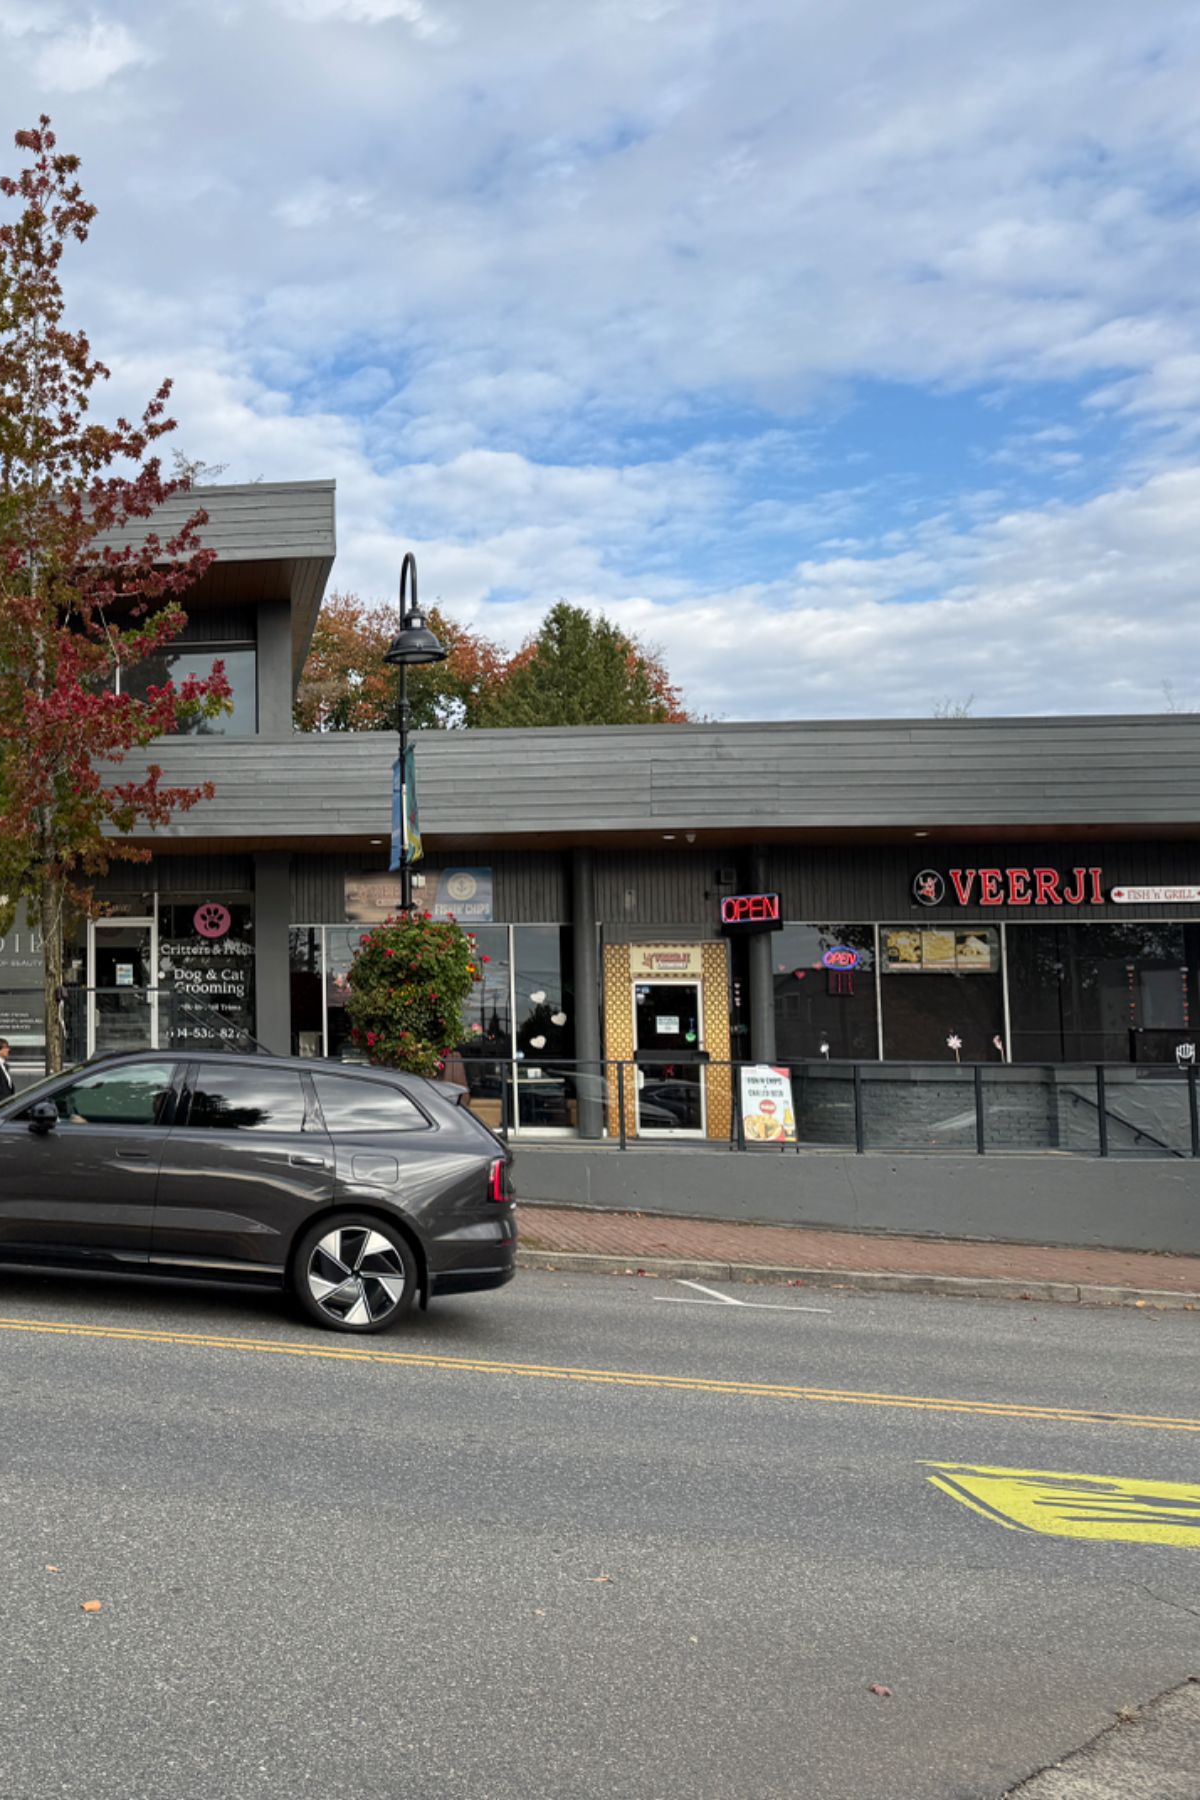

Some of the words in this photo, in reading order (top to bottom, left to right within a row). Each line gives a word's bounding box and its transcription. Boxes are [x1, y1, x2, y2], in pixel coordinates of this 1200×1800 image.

[949, 868, 1104, 905] VEERJI
[1127, 889, 1150, 900] FISH
[1164, 889, 1196, 900] GRILL
[464, 903, 490, 915] CHIPS
[722, 896, 779, 922] OPEN
[161, 943, 210, 955] Critters
[824, 952, 856, 965] OPEN
[174, 968, 203, 984] Dog
[206, 969, 218, 980] &
[221, 968, 245, 980] Cat
[174, 981, 245, 998] Grooming
